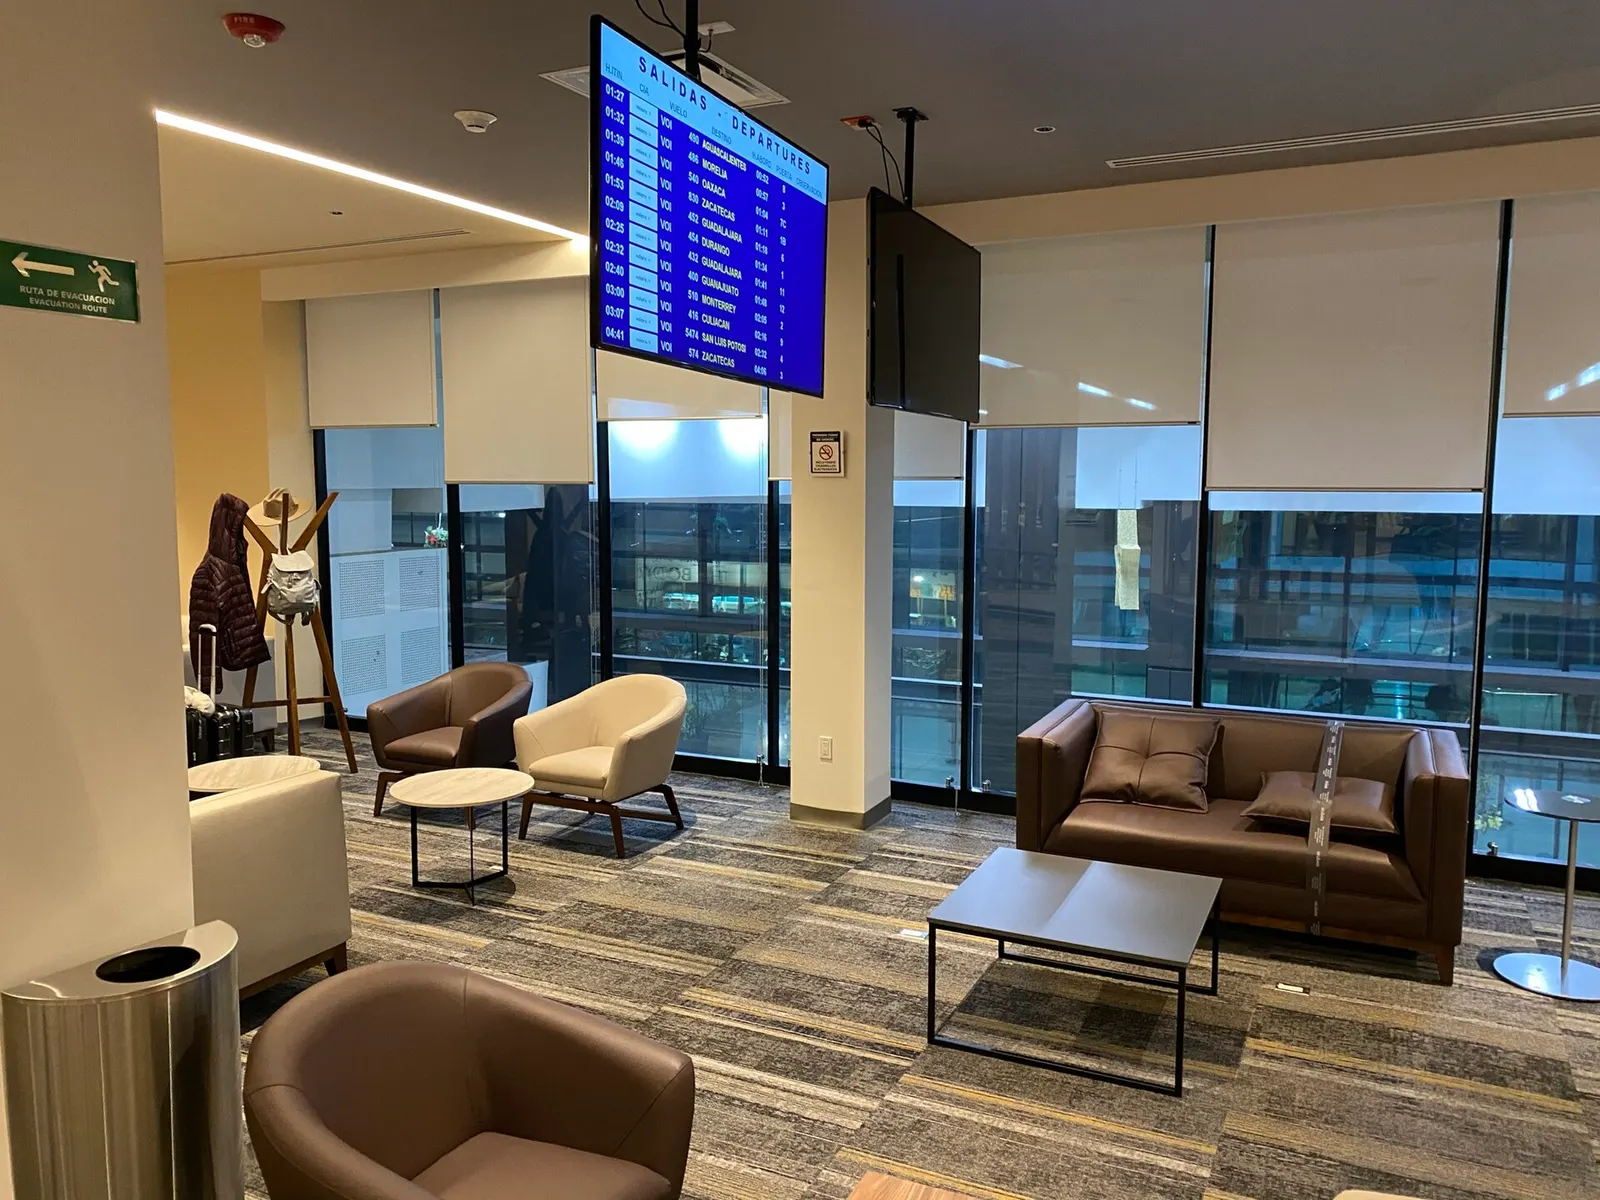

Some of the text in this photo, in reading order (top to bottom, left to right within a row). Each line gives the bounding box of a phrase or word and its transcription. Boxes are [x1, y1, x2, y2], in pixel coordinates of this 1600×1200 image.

[233, 16, 256, 24] FIRE
[605, 83, 625, 103] 01:27
[660, 114, 673, 131] VOI
[701, 139, 747, 172] AGUASCALIENTES
[605, 105, 625, 126] 01:32
[660, 134, 673, 151] VOI
[701, 157, 728, 181] MORELIA
[639, 55, 707, 110] SALIDAS
[732, 115, 811, 175] DEPARTURES
[669, 101, 688, 118] VUELO
[711, 126, 732, 145] DESTINO
[604, 150, 625, 169] 01:46
[659, 176, 672, 192] VOI
[701, 197, 736, 222] ZACATECAS
[605, 128, 625, 147] 01:39
[659, 156, 673, 172] VOI
[687, 171, 700, 185] 540
[701, 178, 726, 199] OAXACA
[604, 172, 625, 191] 01:53
[659, 197, 672, 213] VOI
[687, 211, 699, 225] 452
[701, 217, 743, 244] GUADALAJARA
[604, 195, 625, 213] 02:09
[659, 218, 672, 233] VOI
[687, 231, 699, 244] 454
[701, 236, 731, 257] DURANGO
[604, 238, 625, 256] 02:32
[659, 258, 672, 273] VOI
[701, 275, 740, 297] GUANAJUATO
[779, 304, 786, 314] 12
[604, 260, 625, 277] 02:40
[659, 279, 672, 293] VOI
[687, 289, 699, 302] 510
[701, 293, 737, 314] MONTERREY
[605, 217, 625, 234] 02:25
[659, 238, 672, 253] VOI
[701, 255, 743, 281] GUADALAJARA
[779, 287, 785, 297] 11
[19, 285, 116, 305] RUTA DE EVACUACION
[29, 296, 108, 314] EVACUATION ROUTE
[605, 282, 625, 299] 03:00
[659, 299, 672, 313] VOI
[687, 309, 699, 321] 416
[701, 313, 731, 331] CULIACAN
[605, 304, 625, 320] 03:07
[659, 319, 673, 333] VOI
[684, 327, 699, 341] 5474
[701, 332, 714, 344] SAN
[714, 335, 727, 348] LUIS
[727, 339, 747, 353] POTOSI
[605, 326, 625, 341] 04:41
[660, 340, 673, 353] VOI
[688, 347, 700, 360] 574
[701, 350, 735, 369] ZACATECAS
